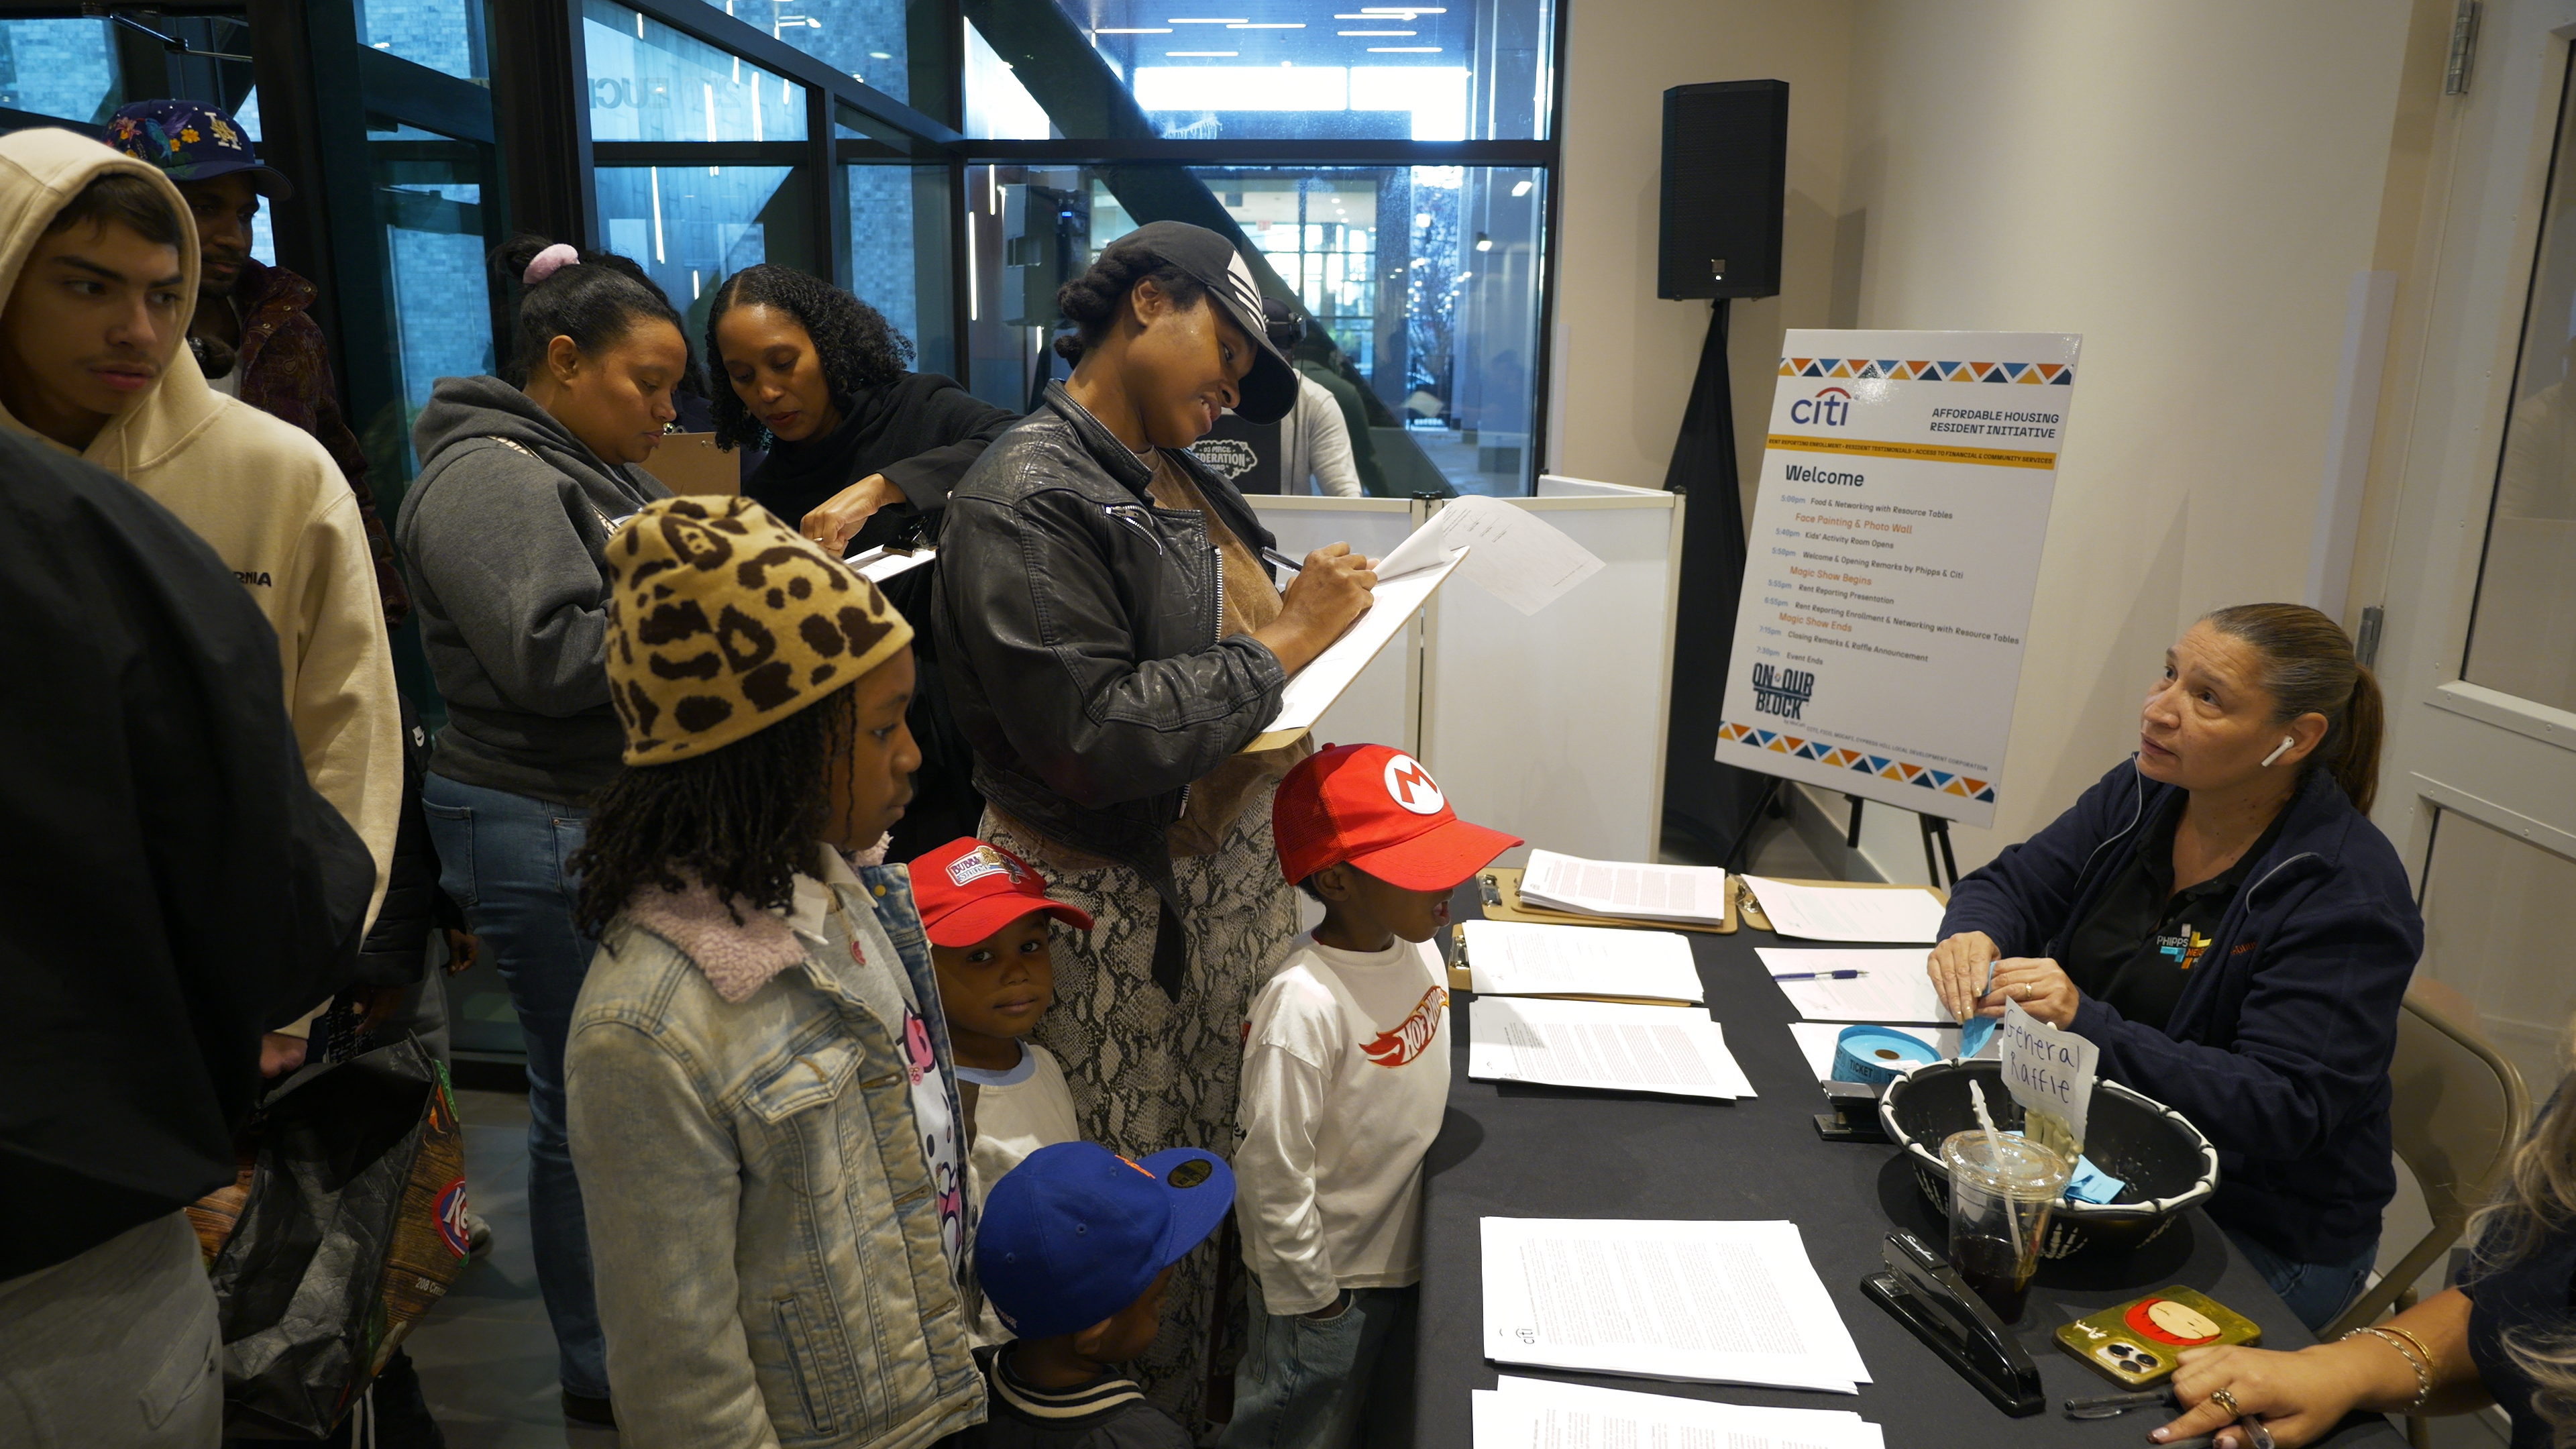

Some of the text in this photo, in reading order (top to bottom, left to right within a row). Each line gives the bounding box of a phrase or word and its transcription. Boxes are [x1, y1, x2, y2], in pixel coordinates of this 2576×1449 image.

[1790, 387, 1851, 426] citi
[1931, 408, 2059, 424] AFFORDABLE HOUSING
[1929, 422, 2056, 439] RESIDENT INITIATIVE
[1845, 443, 1871, 451] RESIDENT
[1871, 445, 1912, 454] TESTIMONIALS
[1945, 451, 1978, 459] FINANCIAL
[1984, 453, 2022, 462] COMMUNITY
[2022, 456, 2053, 464] SERVICES
[1786, 464, 1864, 486] Welcome
[1781, 494, 1806, 504] 5:00pm
[1811, 498, 1827, 506] Food
[1835, 500, 1874, 513] Networking
[1876, 504, 1891, 513] with
[1892, 506, 1926, 517] Resource
[1929, 509, 1953, 519] Tables
[1795, 513, 1913, 535] Face Painting & Photo Wall
[1775, 527, 1894, 549] 5:40pm Kids' Activity Room Opens
[1790, 566, 1872, 586] Magic Show Begins
[1803, 551, 1833, 562] Welcome
[1841, 556, 1870, 568] Opening
[1871, 559, 1902, 572] Remarks
[1904, 564, 1914, 573] by
[1915, 566, 1941, 578] Phipps
[1942, 570, 1947, 578] &
[1950, 570, 1964, 579] Citi
[1799, 584, 1814, 593] Rent
[1815, 586, 1848, 599] Reporting
[1849, 590, 1894, 604] Presentation
[1778, 612, 1853, 633] Magic Show Ends
[1795, 602, 1811, 611] Rent
[1812, 604, 1844, 618] Reporting
[1845, 610, 1884, 623] Enrollment
[1886, 616, 1891, 625] &
[1893, 617, 1935, 633] Networking
[1937, 625, 1953, 634] with
[1955, 627, 1991, 641] Resource
[1993, 633, 2019, 645] Tables
[1786, 651, 1806, 661] Event
[1807, 655, 1823, 665] Ends
[1788, 631, 1813, 643] Closing
[1814, 636, 1843, 648] Remarks
[1844, 641, 1849, 649] &
[1851, 641, 1872, 653] Raffle
[1873, 645, 1929, 663] Announcement
[1752, 662, 1815, 697] ON OUR
[1755, 690, 1803, 720] BLOCK
[1892, 745, 1908, 754] LOCAL
[1909, 749, 1947, 762] DEVELOPMENT
[1948, 757, 1988, 772] CORPORATION
[1394, 761, 1438, 804] M
[2156, 934, 2189, 948] PHIPPS
[2005, 1008, 2080, 1073] General
[1849, 1059, 1874, 1078] TICKET
[2010, 1051, 2071, 1104] Raffle
[415, 1276, 429, 1291] 208
[1515, 1328, 1535, 1344] citi
